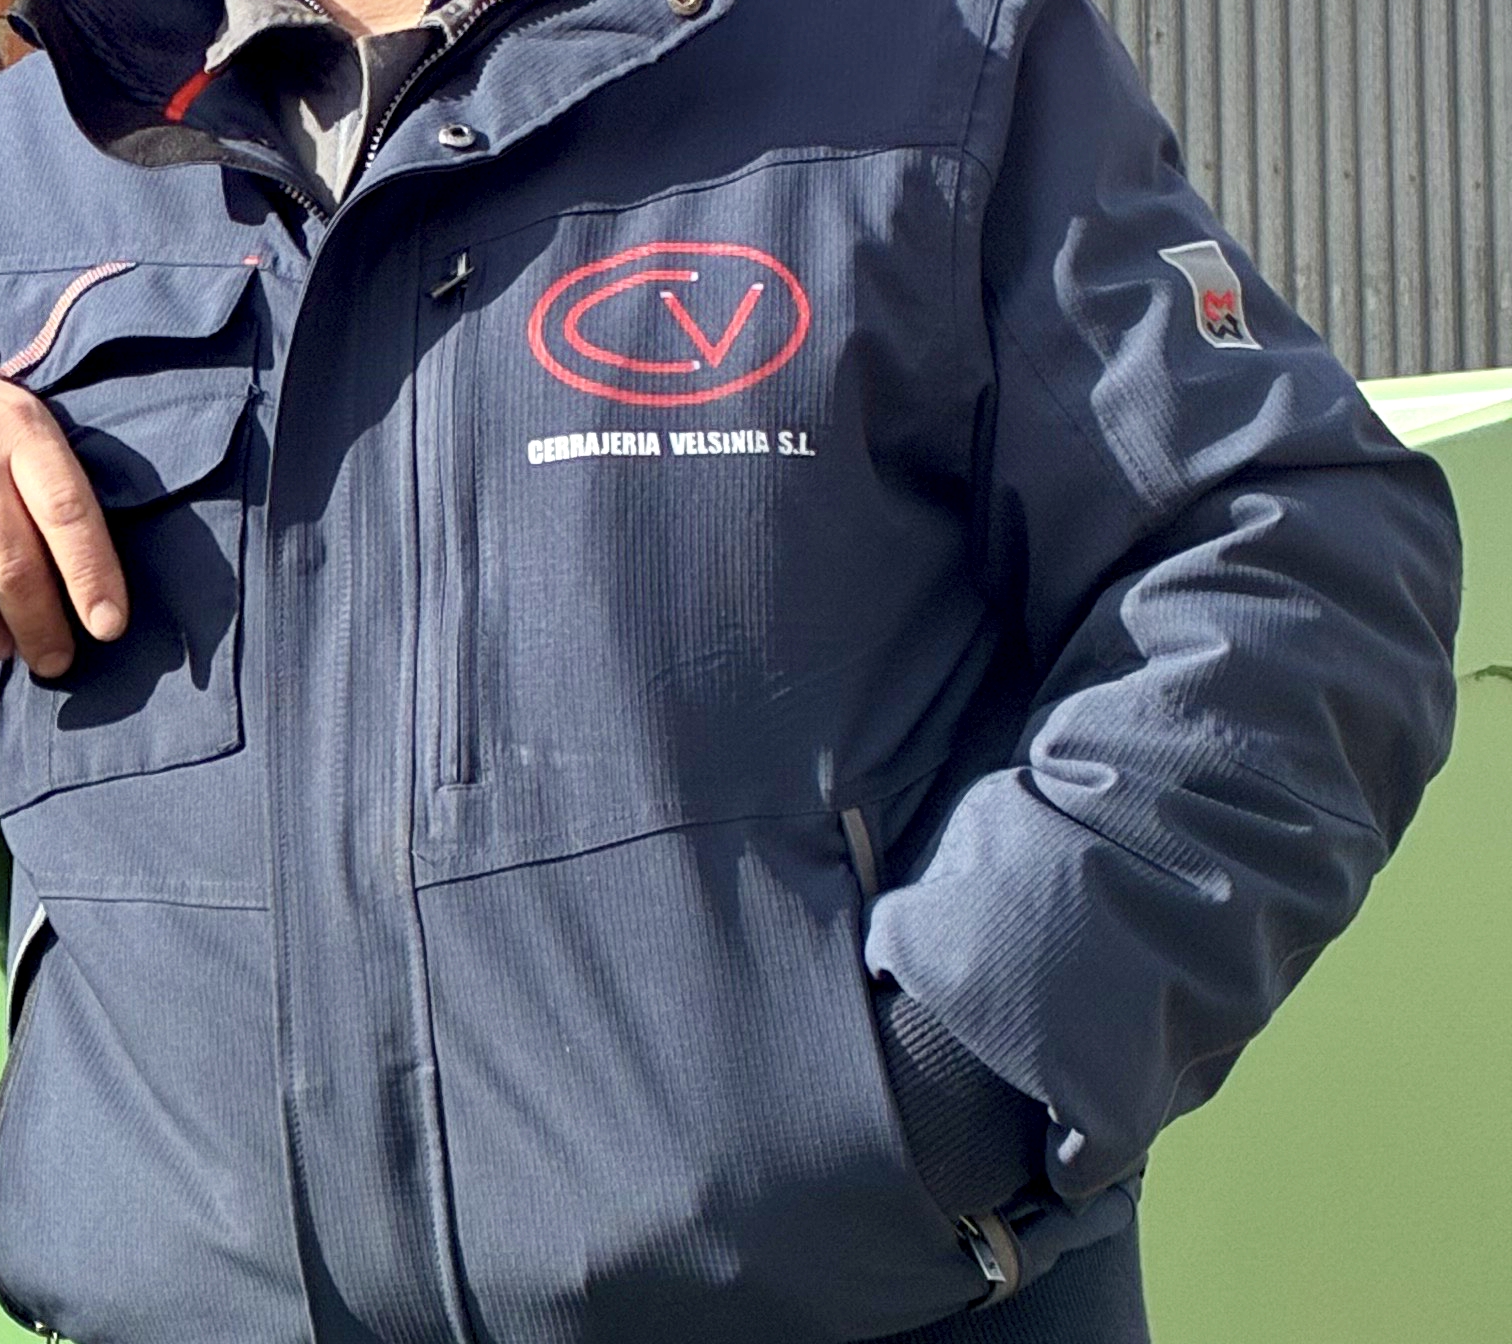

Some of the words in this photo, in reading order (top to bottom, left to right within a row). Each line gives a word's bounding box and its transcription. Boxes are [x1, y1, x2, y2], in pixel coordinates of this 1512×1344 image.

[563, 269, 764, 373] CV
[527, 431, 661, 465] CERRAJERIA
[668, 429, 770, 456] VELSINIA
[777, 430, 816, 457] S.L.
